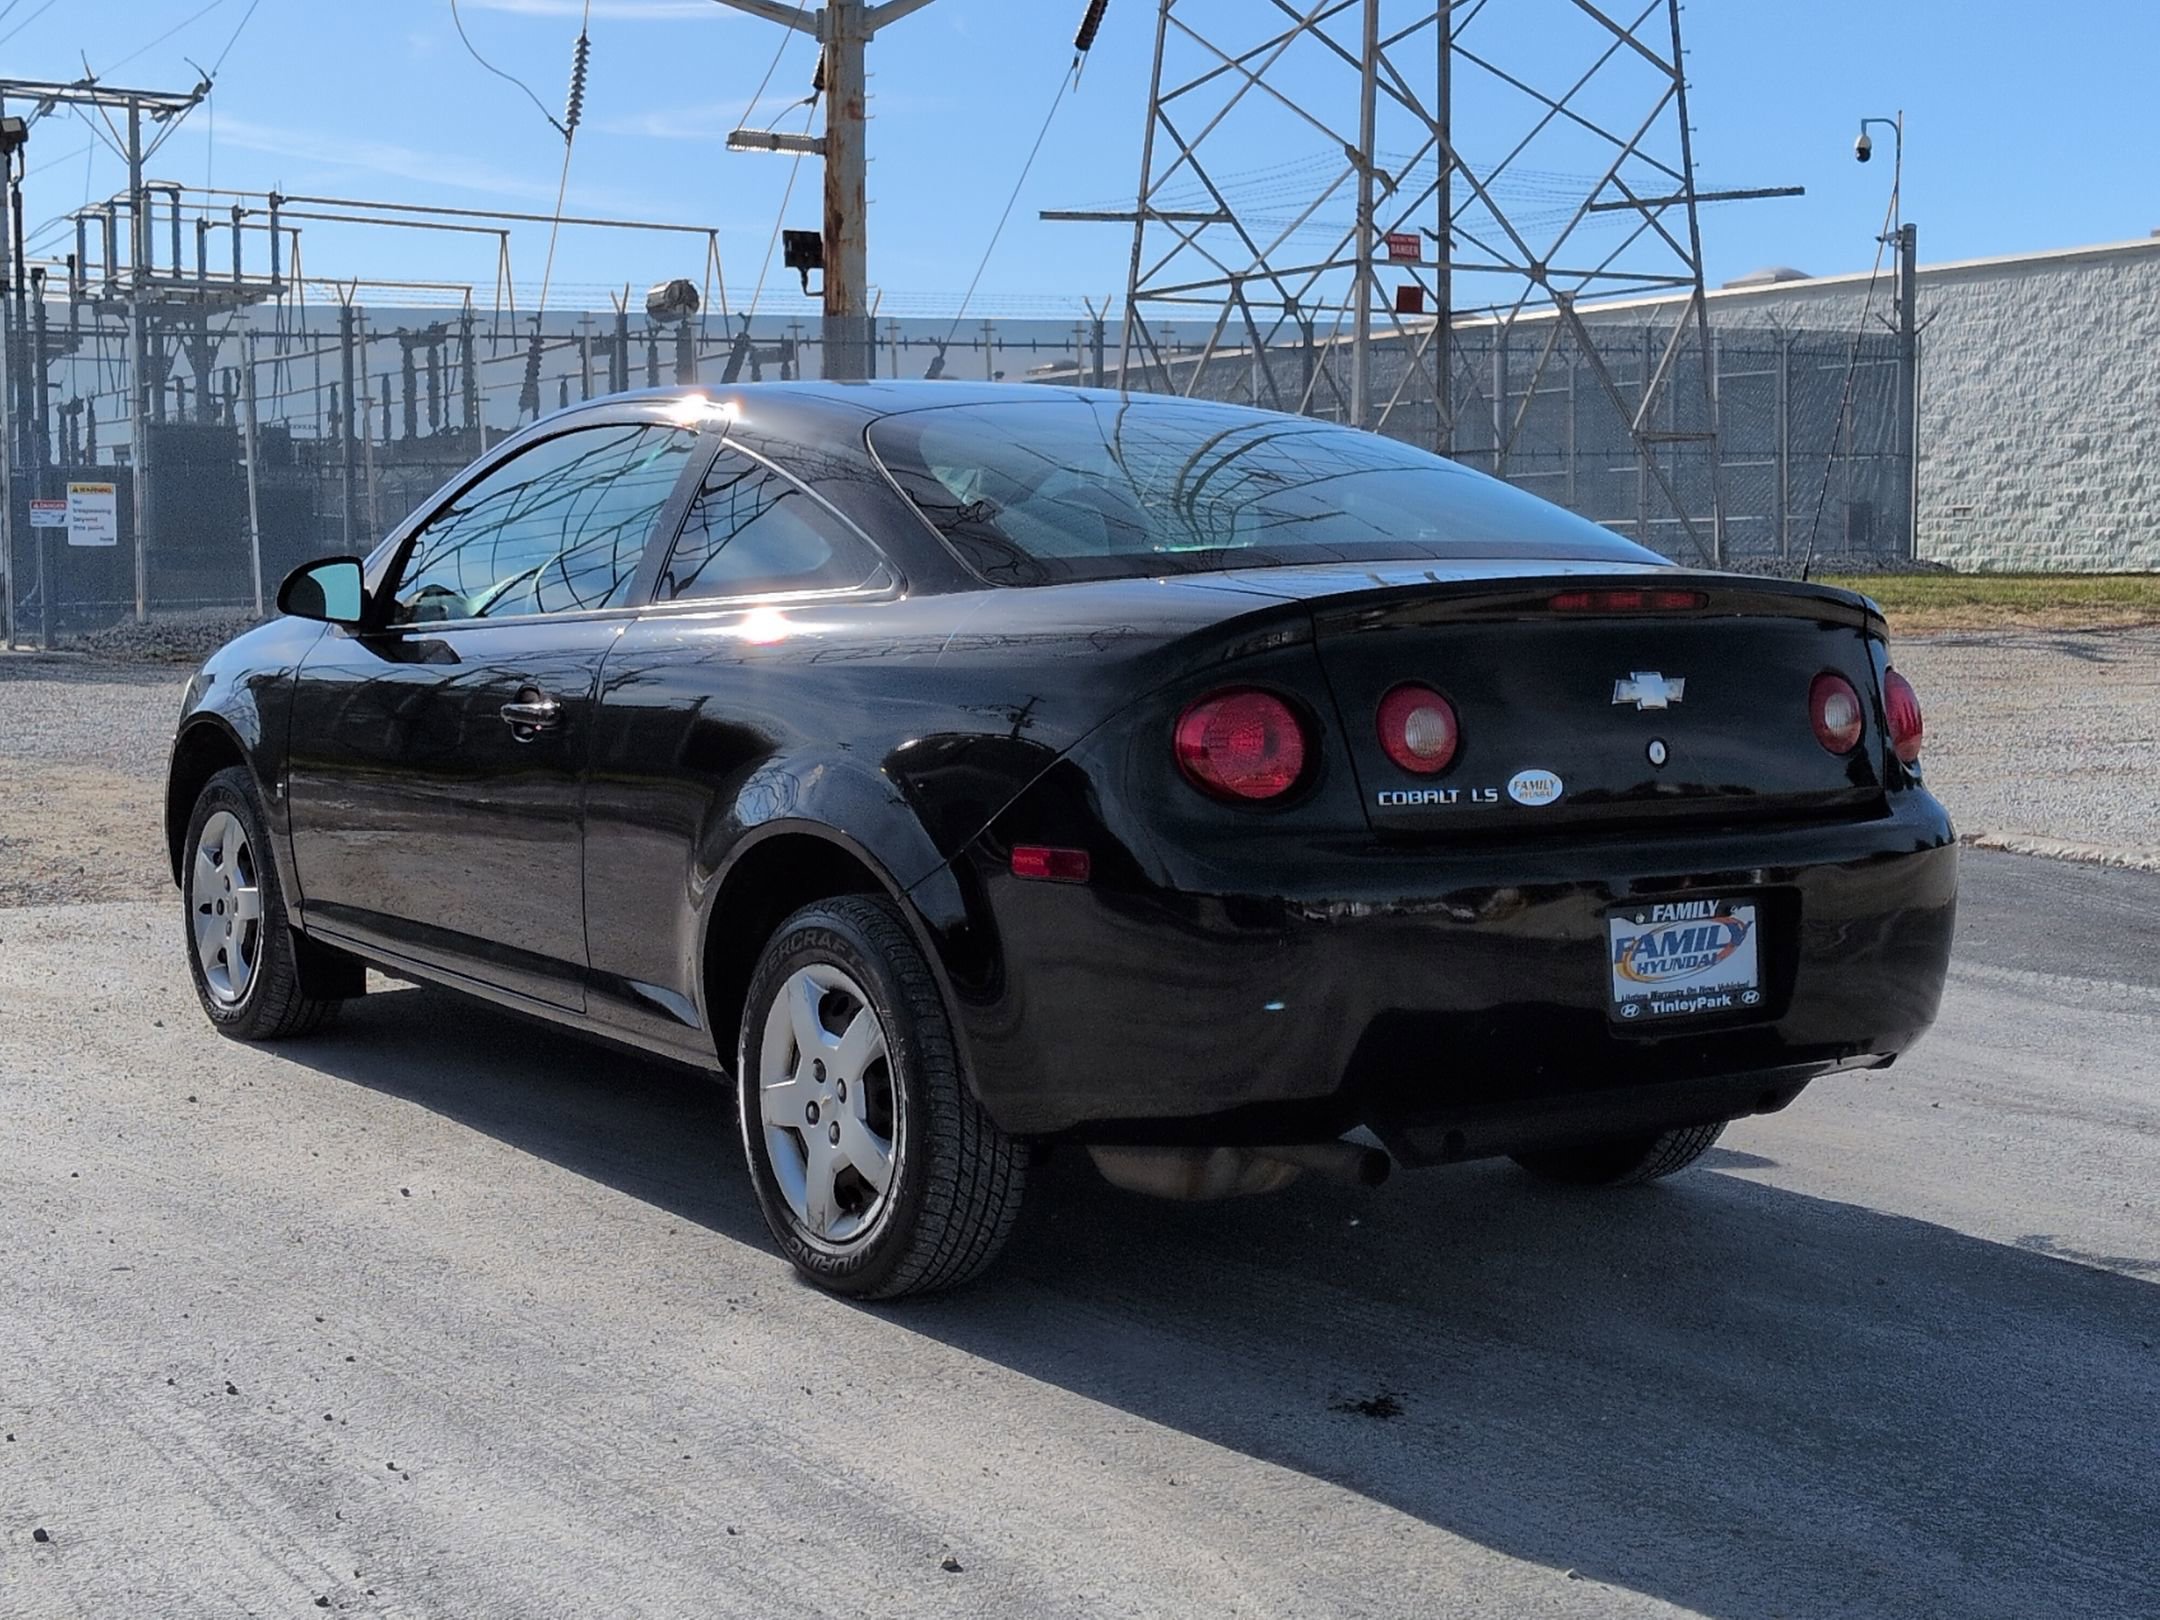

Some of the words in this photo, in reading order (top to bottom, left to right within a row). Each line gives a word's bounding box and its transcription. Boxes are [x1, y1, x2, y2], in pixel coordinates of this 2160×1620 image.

[1391, 244, 1418, 256] DANGER
[1513, 778, 1557, 791] FAMILY
[1378, 789, 1460, 806] COBALT
[1471, 788, 1498, 803] LS
[1652, 900, 1720, 921] FAMILY
[1614, 921, 1754, 964] FAMILY
[1636, 953, 1716, 975] HYUNDAI
[1651, 995, 1732, 1014] TinleyPark
